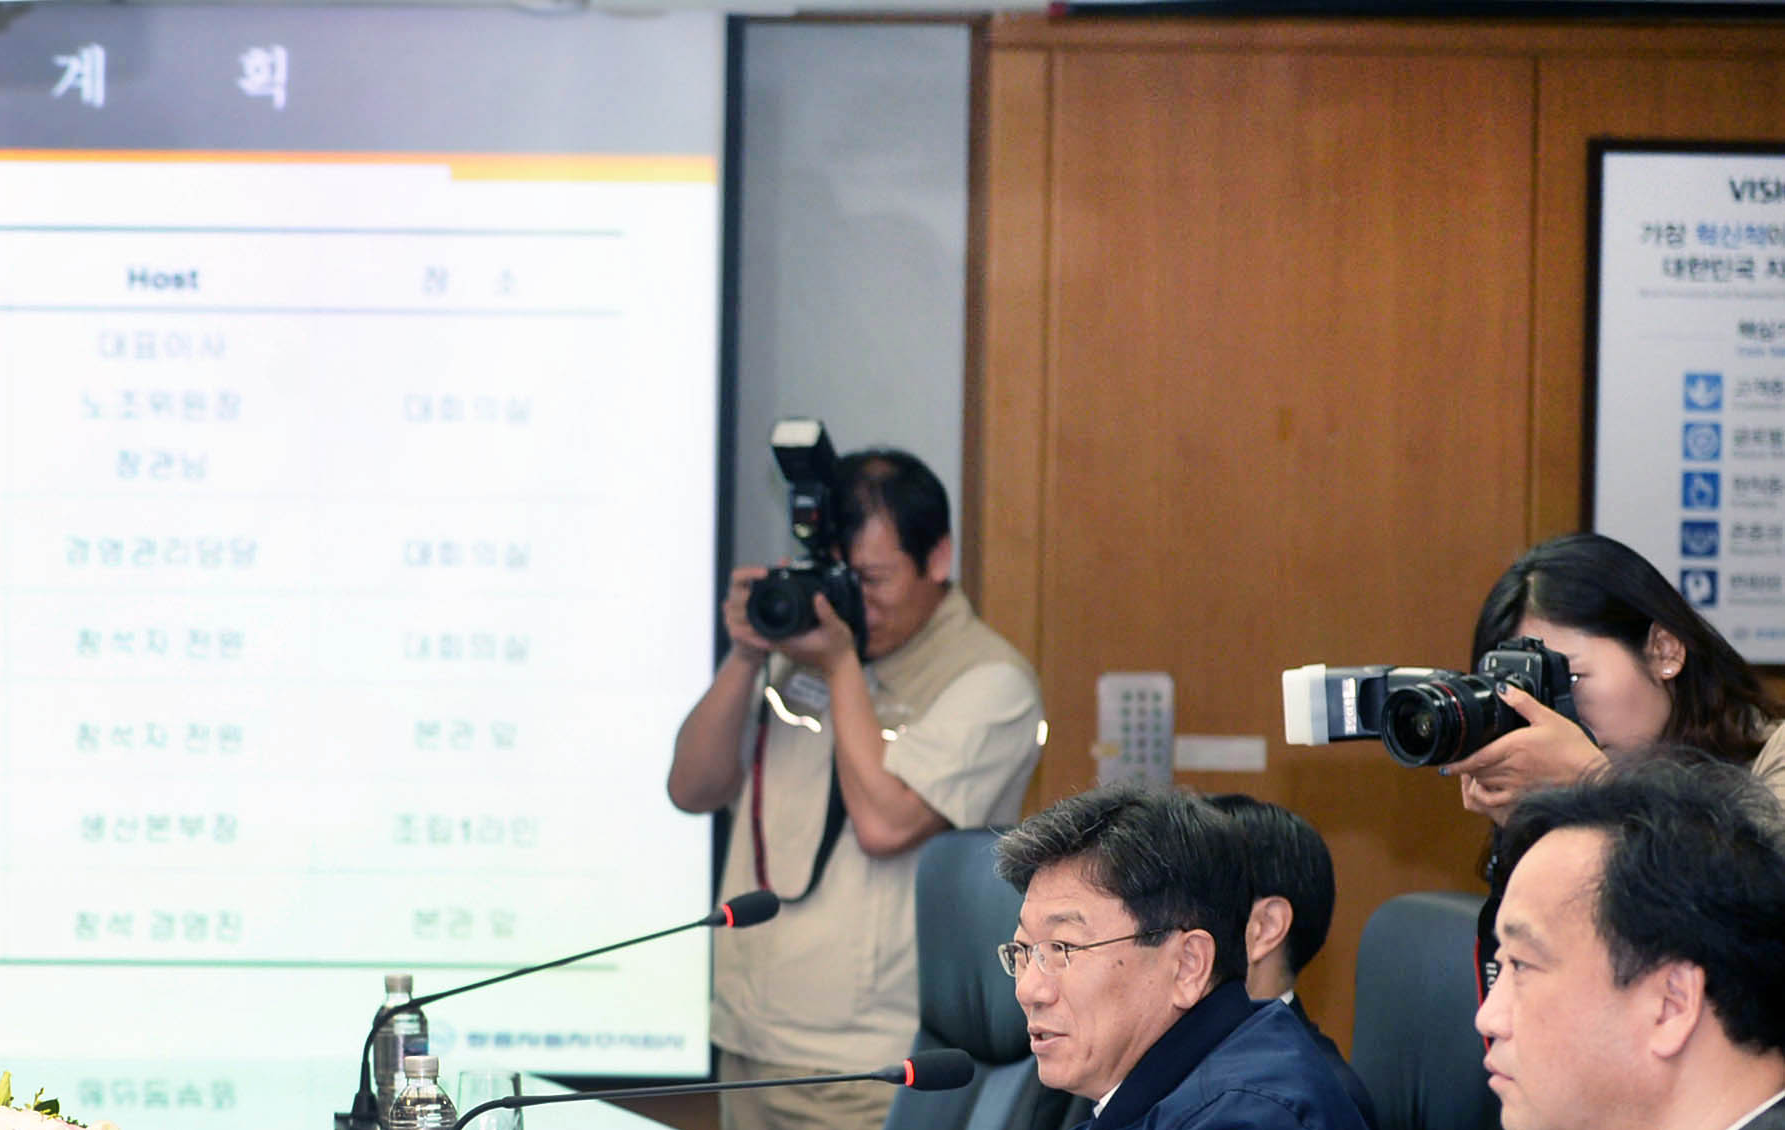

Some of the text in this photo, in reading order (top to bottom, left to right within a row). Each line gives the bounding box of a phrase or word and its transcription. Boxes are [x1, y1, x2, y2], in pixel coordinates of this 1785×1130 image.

[51, 43, 107, 108] 계
[237, 44, 289, 110] 획
[1729, 176, 1785, 203] VISI
[126, 267, 200, 292] Host
